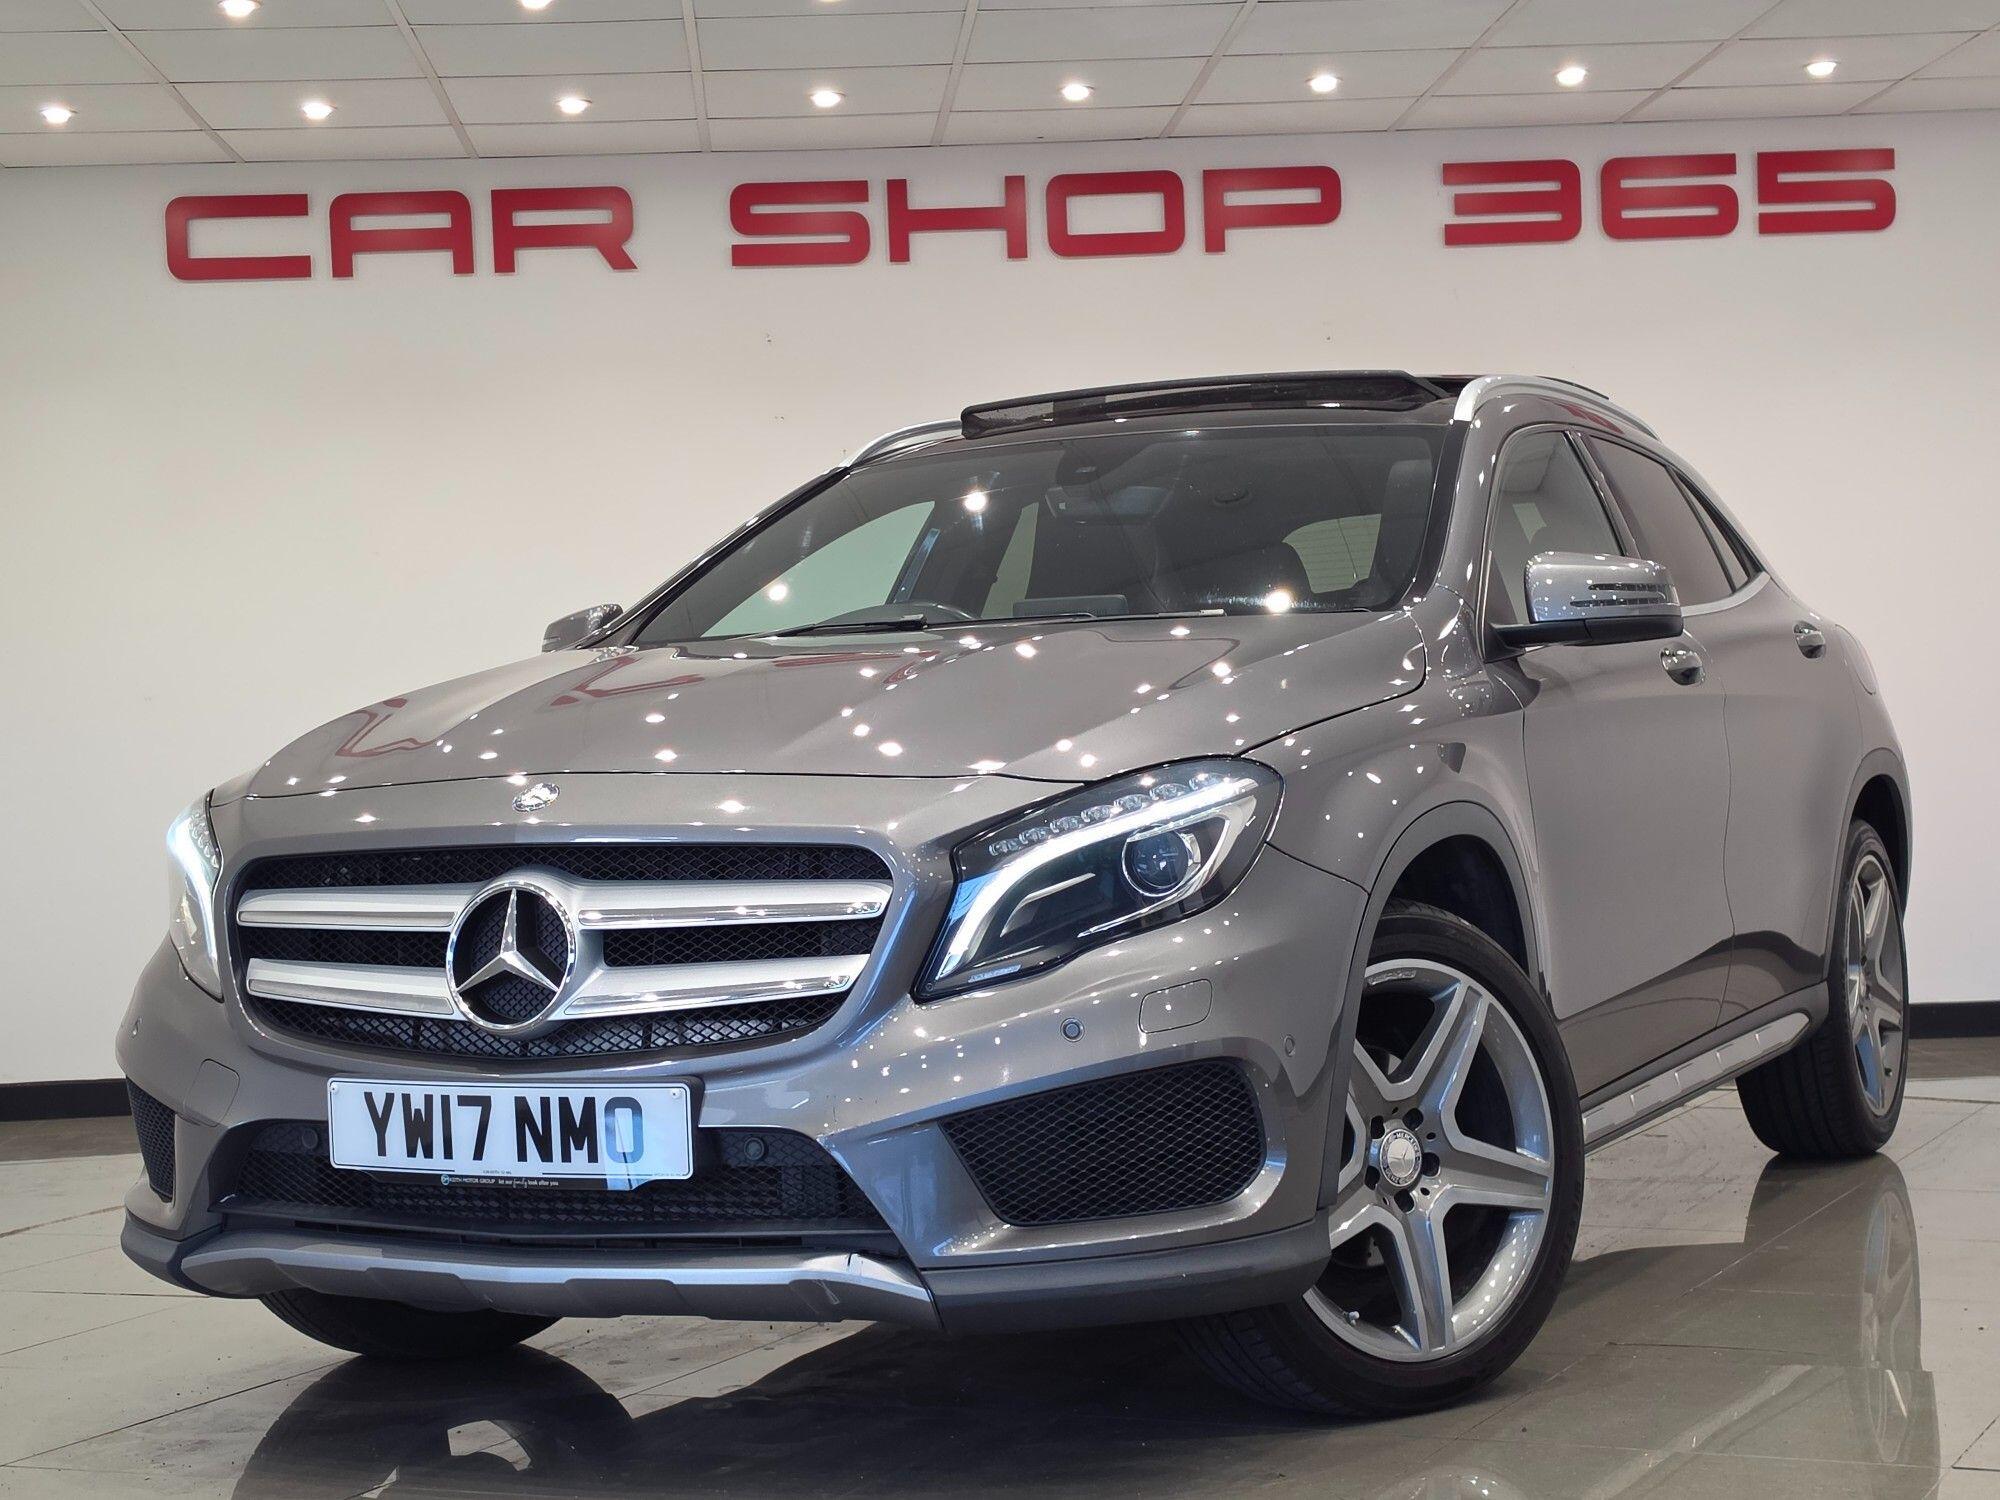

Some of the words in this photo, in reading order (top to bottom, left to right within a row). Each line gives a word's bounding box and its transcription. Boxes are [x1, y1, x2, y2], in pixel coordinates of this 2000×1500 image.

[165, 185, 638, 281] CAR
[730, 165, 1342, 267] SHOP
[1443, 148, 1896, 245] 365
[364, 1091, 493, 1162] YW17
[514, 1096, 645, 1165] NMO
